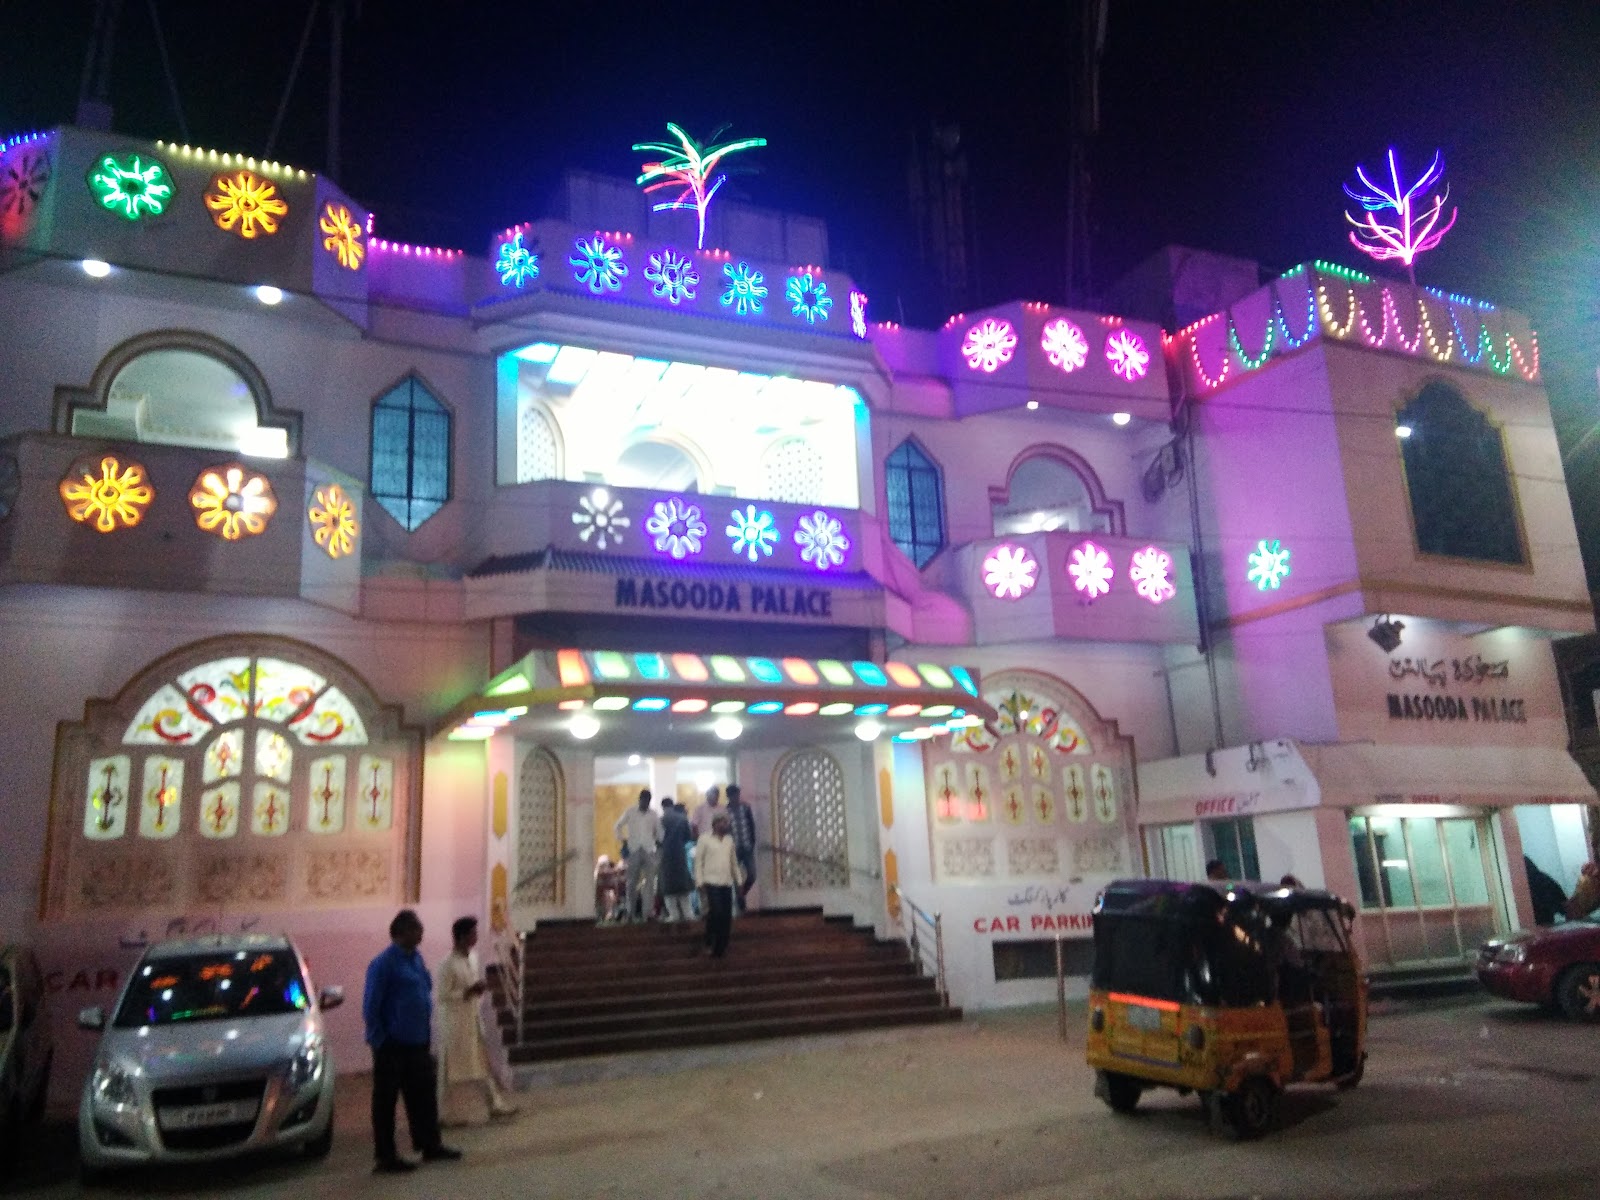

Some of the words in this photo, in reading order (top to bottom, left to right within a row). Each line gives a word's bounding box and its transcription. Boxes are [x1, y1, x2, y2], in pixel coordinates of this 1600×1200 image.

[615, 578, 741, 611] MASOODA
[750, 586, 833, 617] PALACE
[1387, 694, 1468, 720] MASOODA
[1471, 696, 1527, 722] PALACE
[1195, 797, 1236, 815] OFFICE
[973, 915, 1020, 934] CAR
[45, 969, 118, 993] CAR
